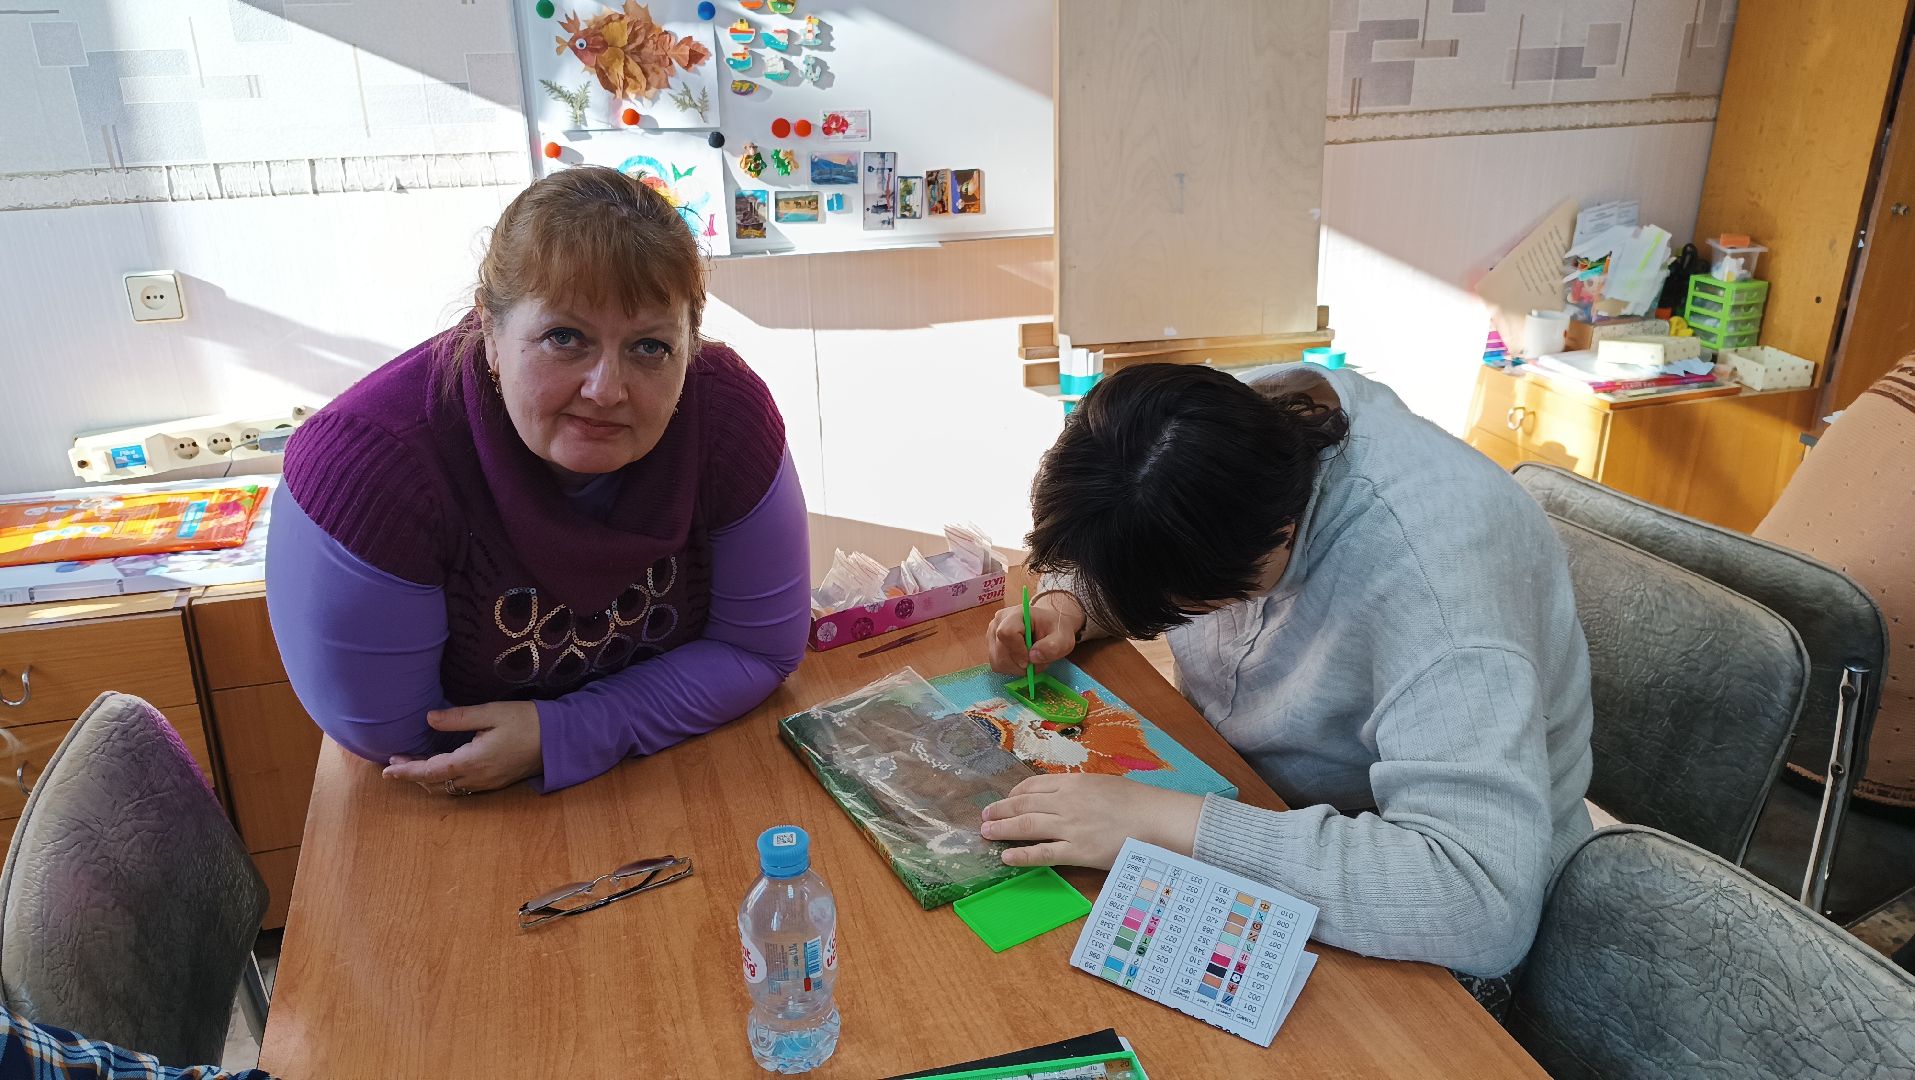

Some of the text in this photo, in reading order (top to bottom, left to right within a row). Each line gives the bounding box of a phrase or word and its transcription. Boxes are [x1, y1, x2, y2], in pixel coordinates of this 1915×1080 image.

[1218, 886, 1293, 918] 010 783
[1164, 934, 1177, 943] 027
[1269, 940, 1281, 949] 007
[1188, 955, 1201, 964] 310
[1247, 991, 1261, 1001] 002
[1243, 1002, 1257, 1012] 001
